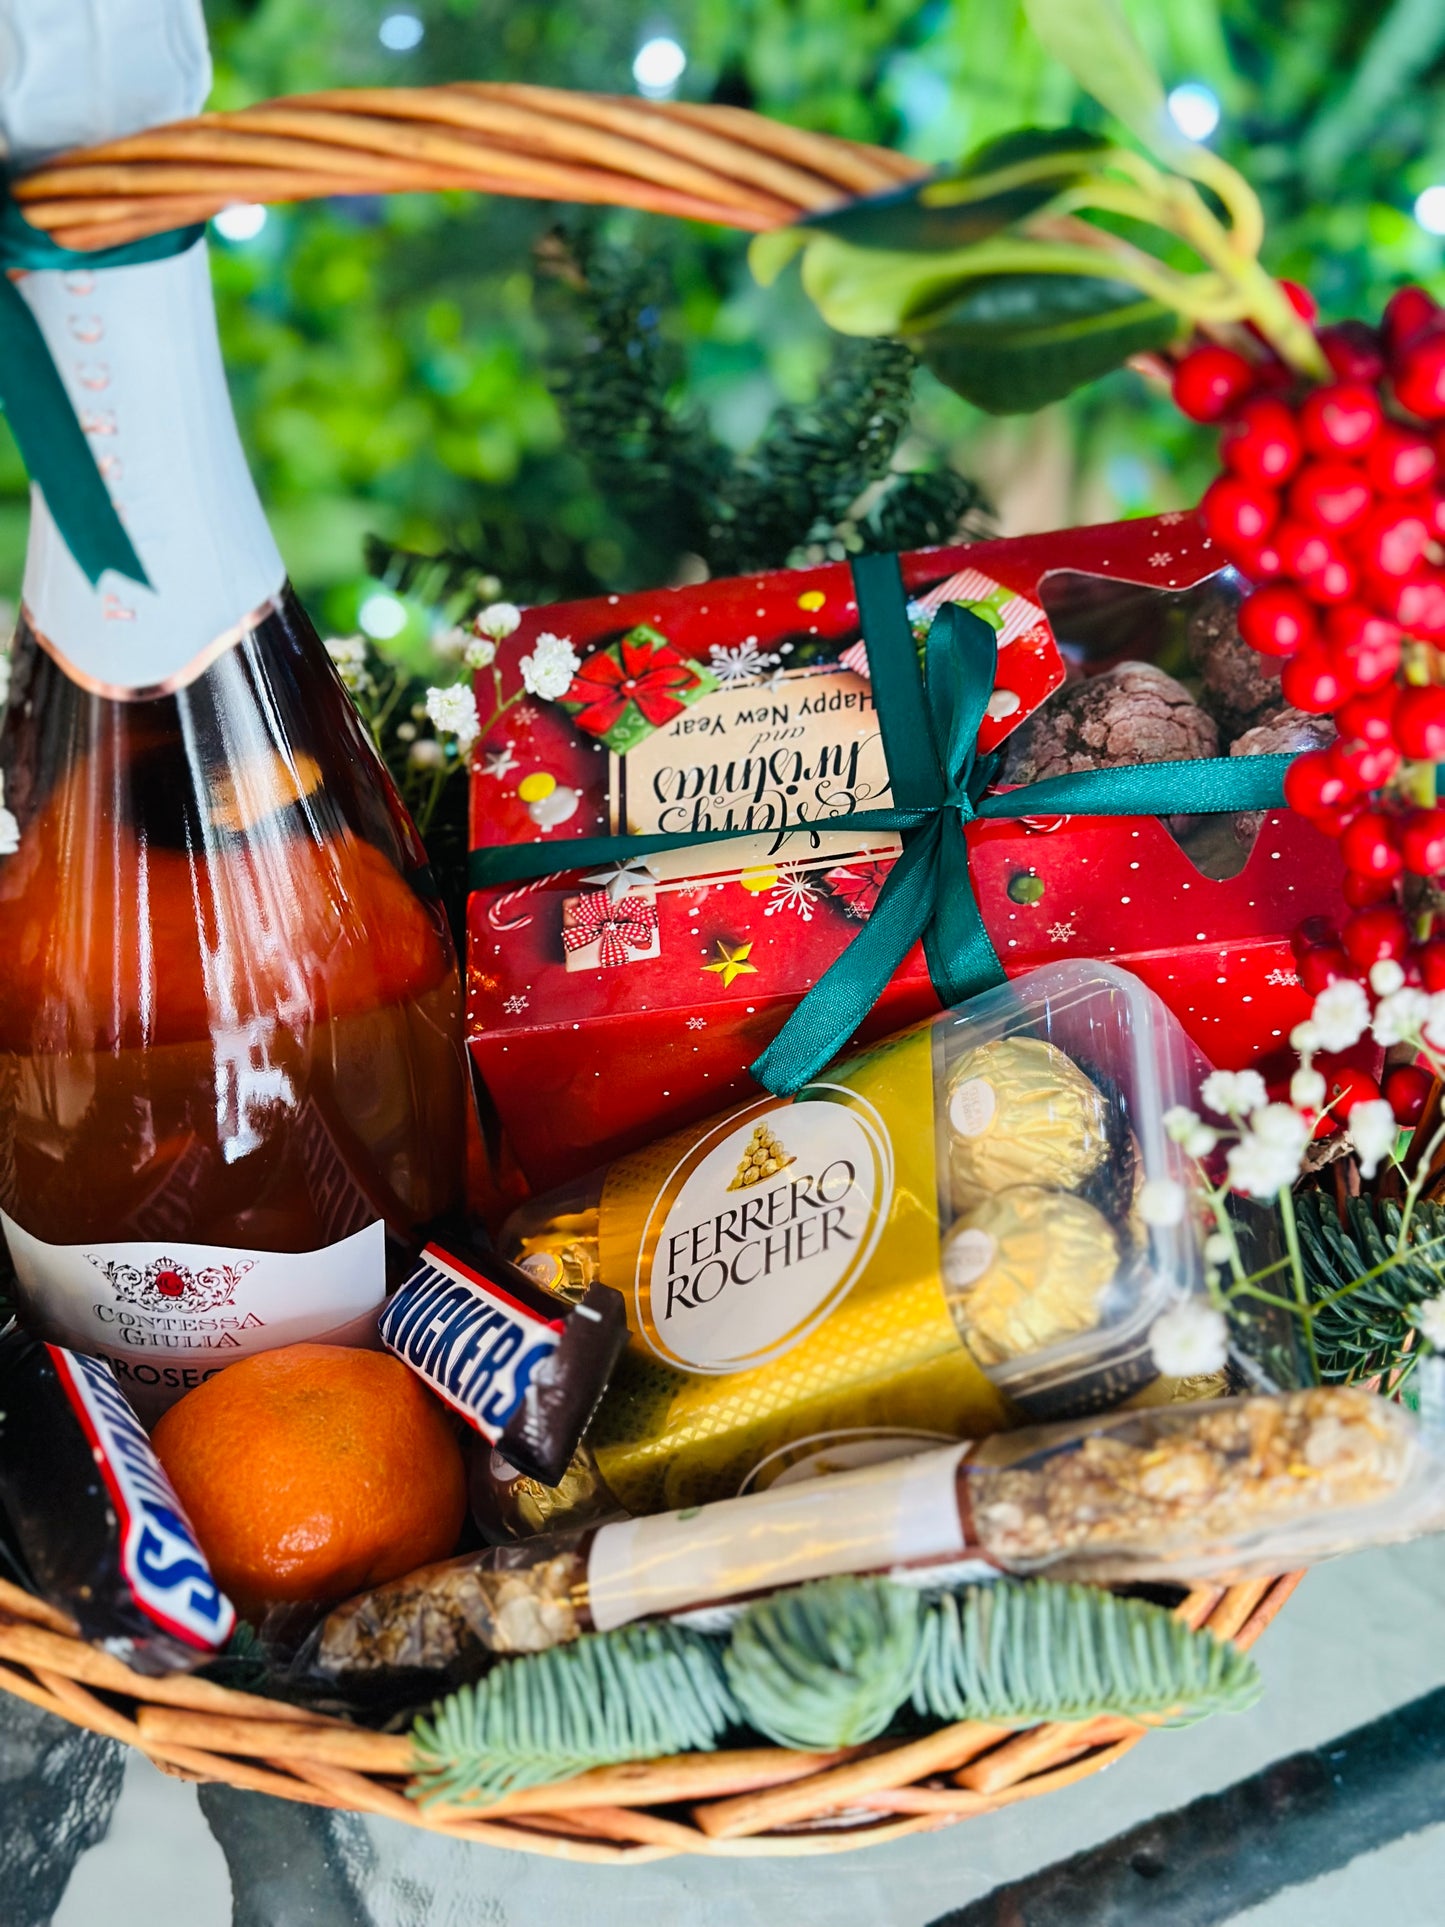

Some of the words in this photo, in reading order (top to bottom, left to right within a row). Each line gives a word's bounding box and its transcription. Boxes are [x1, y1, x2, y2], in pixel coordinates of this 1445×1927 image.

[735, 704, 788, 727] New
[800, 688, 877, 718] Happy
[669, 715, 726, 737] Year
[749, 725, 805, 753] and
[667, 1160, 856, 1276] FERRERO
[664, 1206, 857, 1320] ROCHER
[93, 1303, 266, 1332] CONTESSA
[119, 1327, 241, 1349] GIULIA
